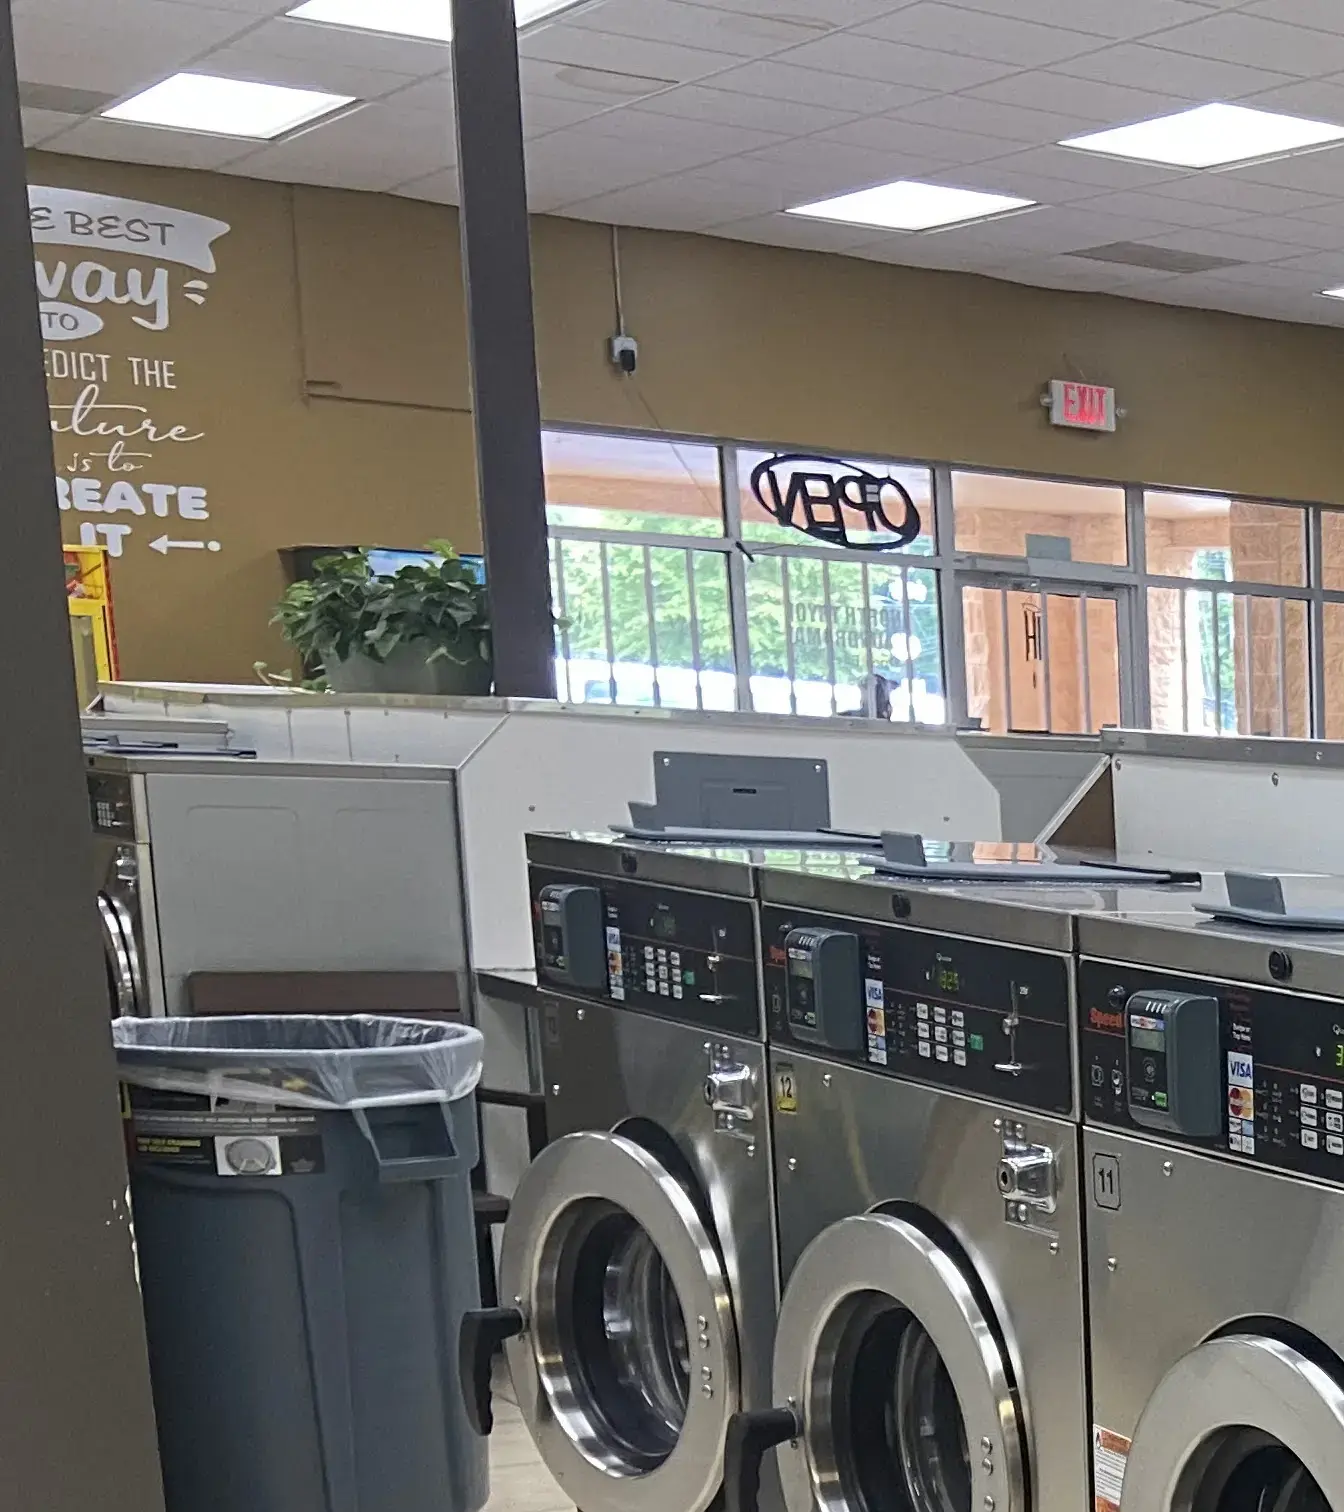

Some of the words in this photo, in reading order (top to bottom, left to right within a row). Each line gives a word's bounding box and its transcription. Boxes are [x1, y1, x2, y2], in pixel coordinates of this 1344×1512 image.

[64, 210, 175, 246] BEST
[40, 311, 79, 331] TO
[128, 356, 178, 389] THE
[1063, 382, 1107, 426] EXIT
[67, 452, 92, 472] is
[90, 441, 152, 472] to
[80, 522, 132, 558] IT
[1231, 1061, 1253, 1079] VISA
[780, 1076, 793, 1098] 12
[1098, 1168, 1113, 1195] 11
